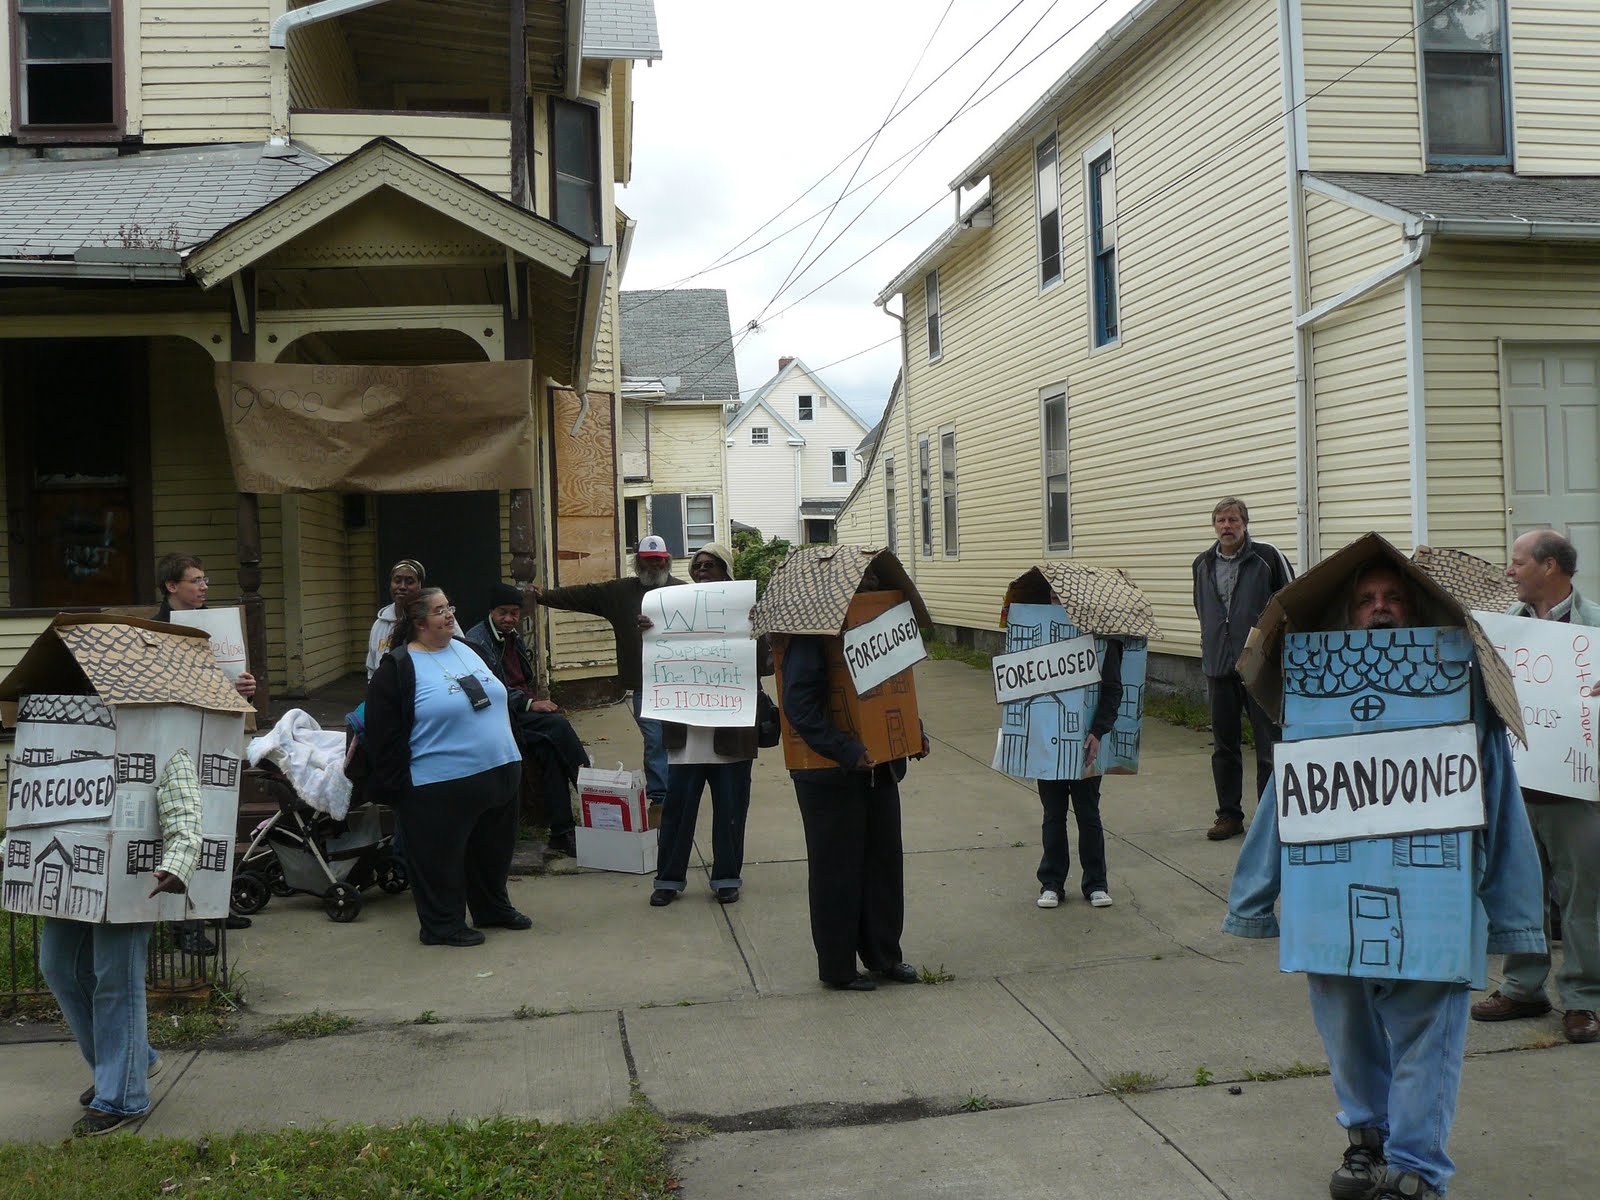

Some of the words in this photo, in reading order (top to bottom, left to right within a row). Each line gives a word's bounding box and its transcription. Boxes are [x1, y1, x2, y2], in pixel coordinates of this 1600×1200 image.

[234, 386, 323, 424] 9000
[658, 589, 727, 631] WE
[845, 617, 918, 679] FORECLOSED
[1494, 645, 1553, 684] RO
[690, 665, 742, 688] Right
[996, 649, 1096, 691] FORECLOSED
[1563, 746, 1596, 784] 4th
[9, 774, 115, 812] FORECLOSED
[1282, 753, 1478, 818] ABANDONED
